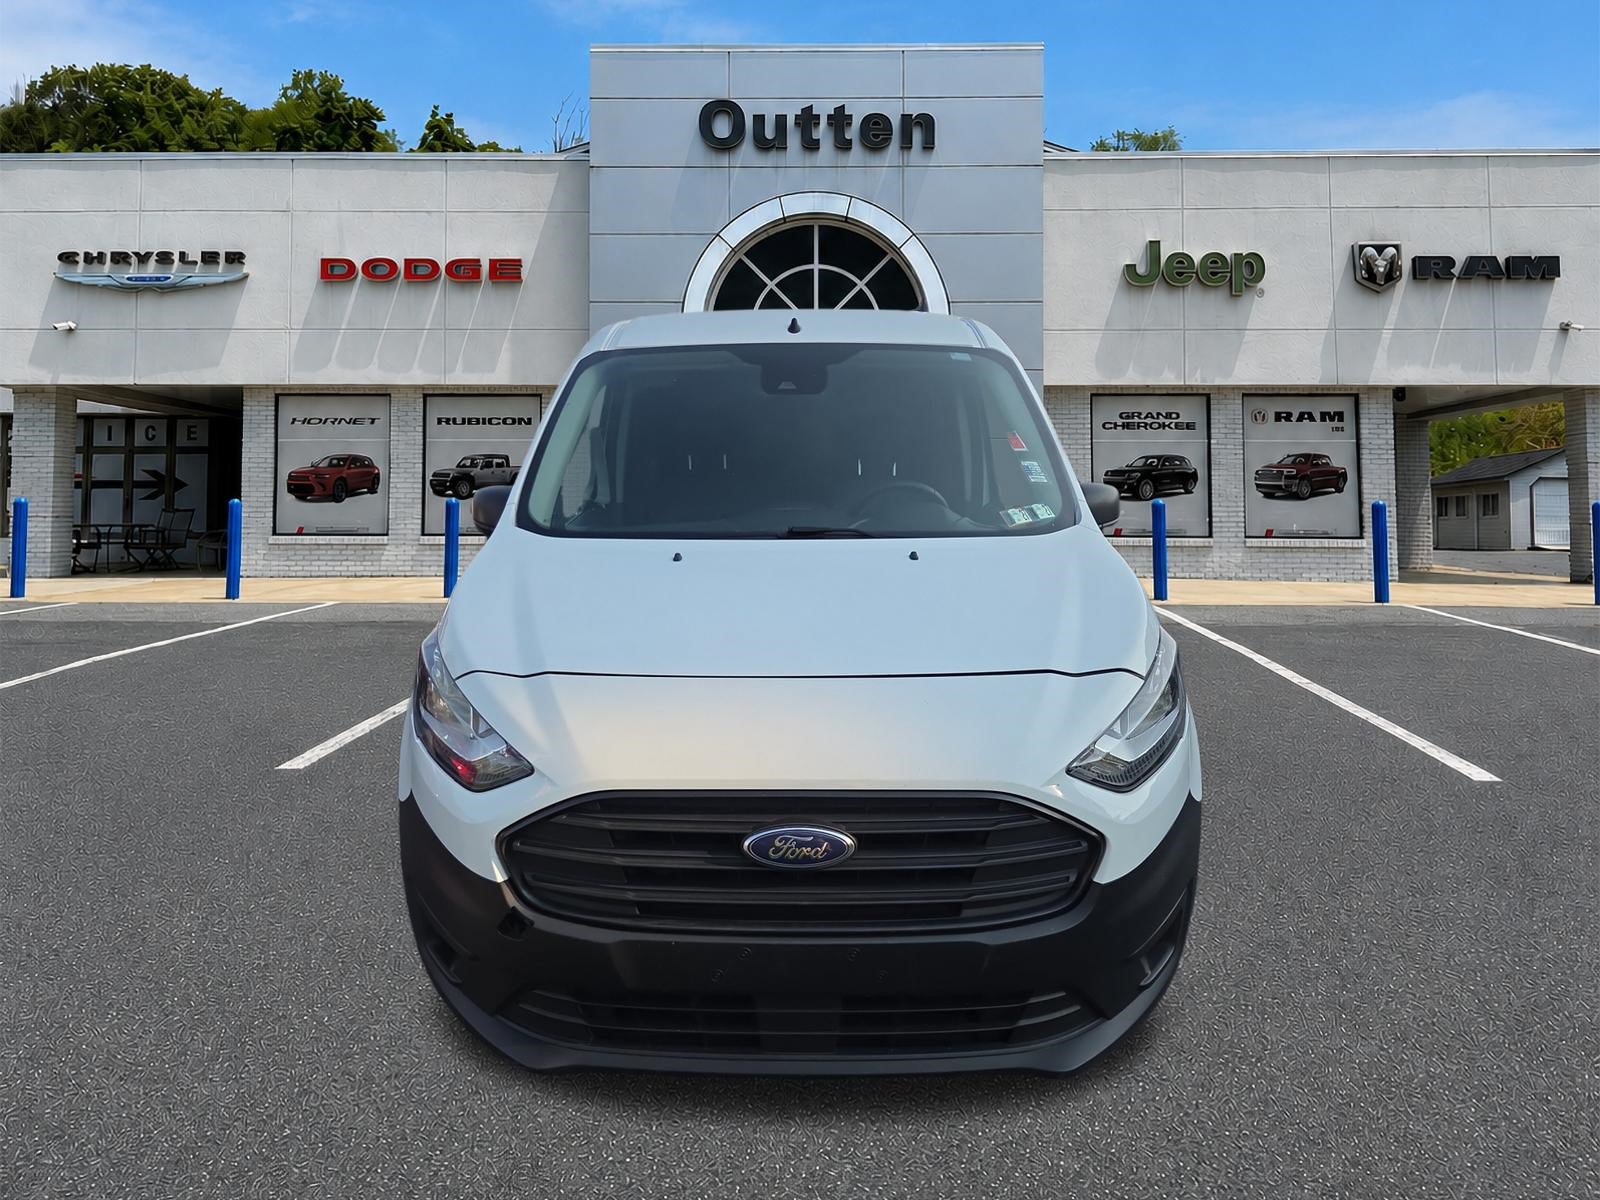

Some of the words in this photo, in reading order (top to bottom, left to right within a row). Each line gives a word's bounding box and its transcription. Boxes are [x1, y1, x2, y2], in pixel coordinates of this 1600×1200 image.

[698, 99, 936, 150] Outten
[56, 250, 247, 266] CHRYSLER
[320, 257, 523, 282] DODGE
[1123, 240, 1267, 297] Jeep
[1412, 255, 1561, 280] RAM
[290, 417, 381, 426] HORNET
[436, 416, 533, 426] RUBICON
[1118, 411, 1181, 421] GRAND
[1273, 410, 1345, 423] RAM
[1101, 421, 1197, 431] CHEROKEE
[769, 834, 829, 859] Ford
